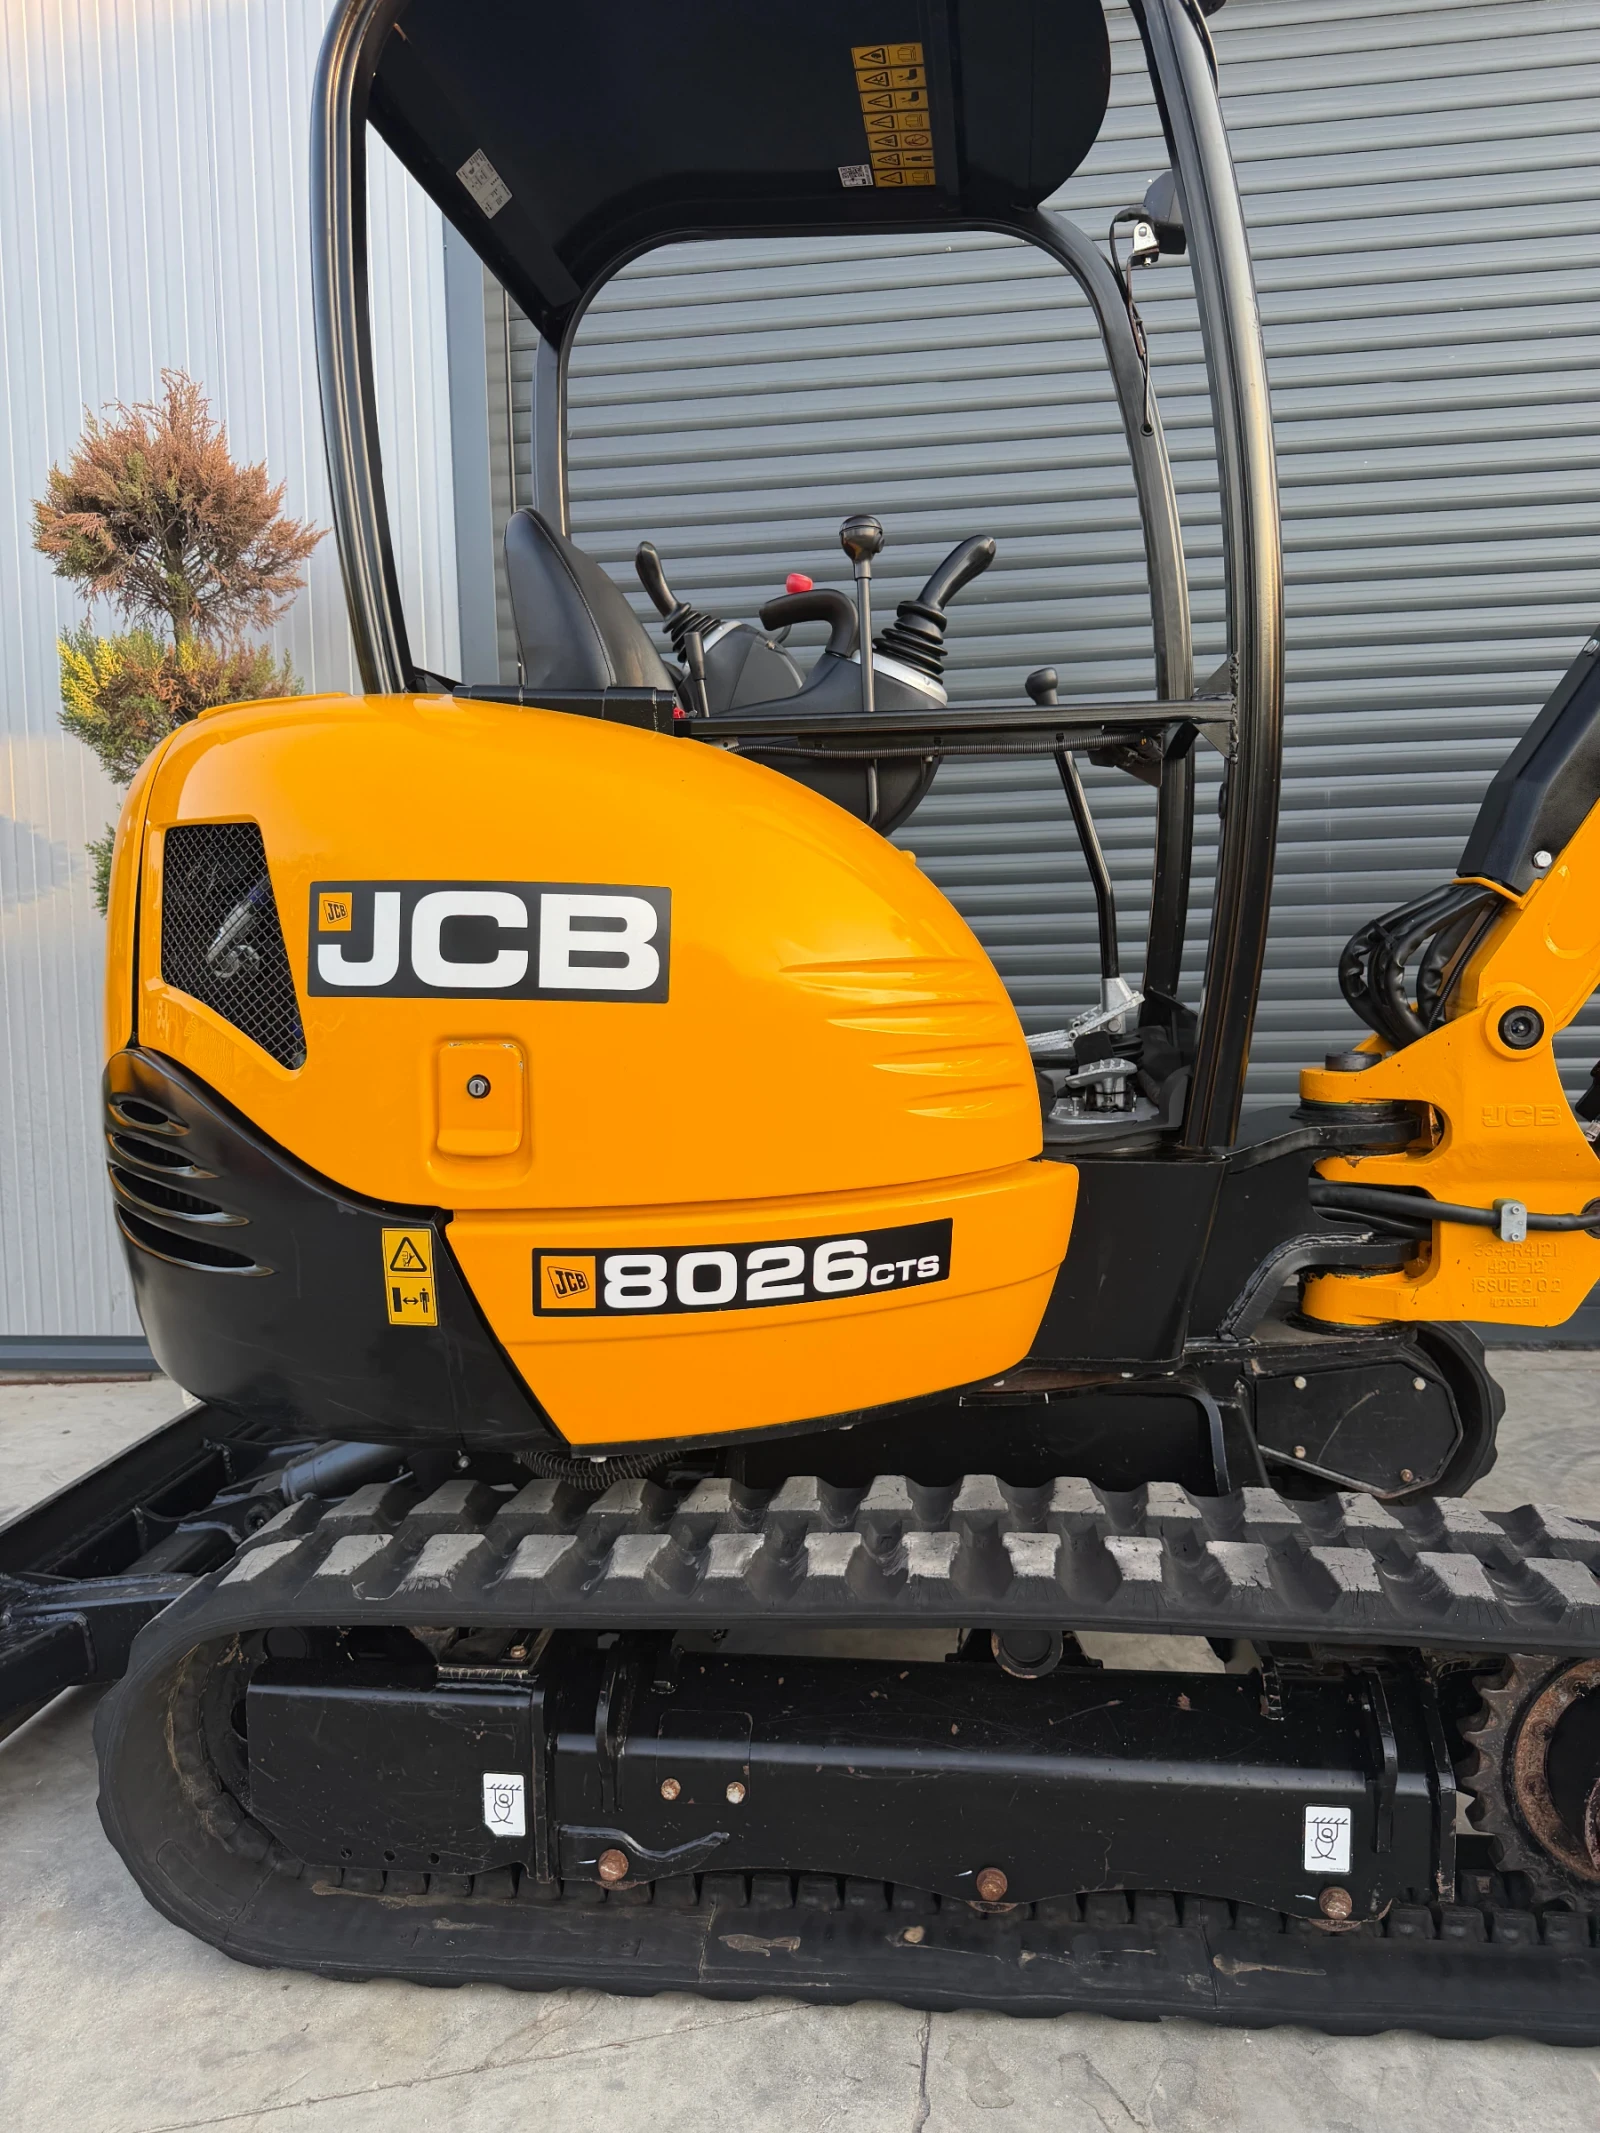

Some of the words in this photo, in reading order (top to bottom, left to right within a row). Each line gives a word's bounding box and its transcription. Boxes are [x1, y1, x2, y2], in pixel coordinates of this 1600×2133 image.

[327, 902, 347, 921] JCB
[317, 890, 660, 991] JCB
[1481, 1104, 1562, 1128] JCB
[554, 1269, 587, 1295] JCB
[1471, 1277, 1519, 1294] ISSUE
